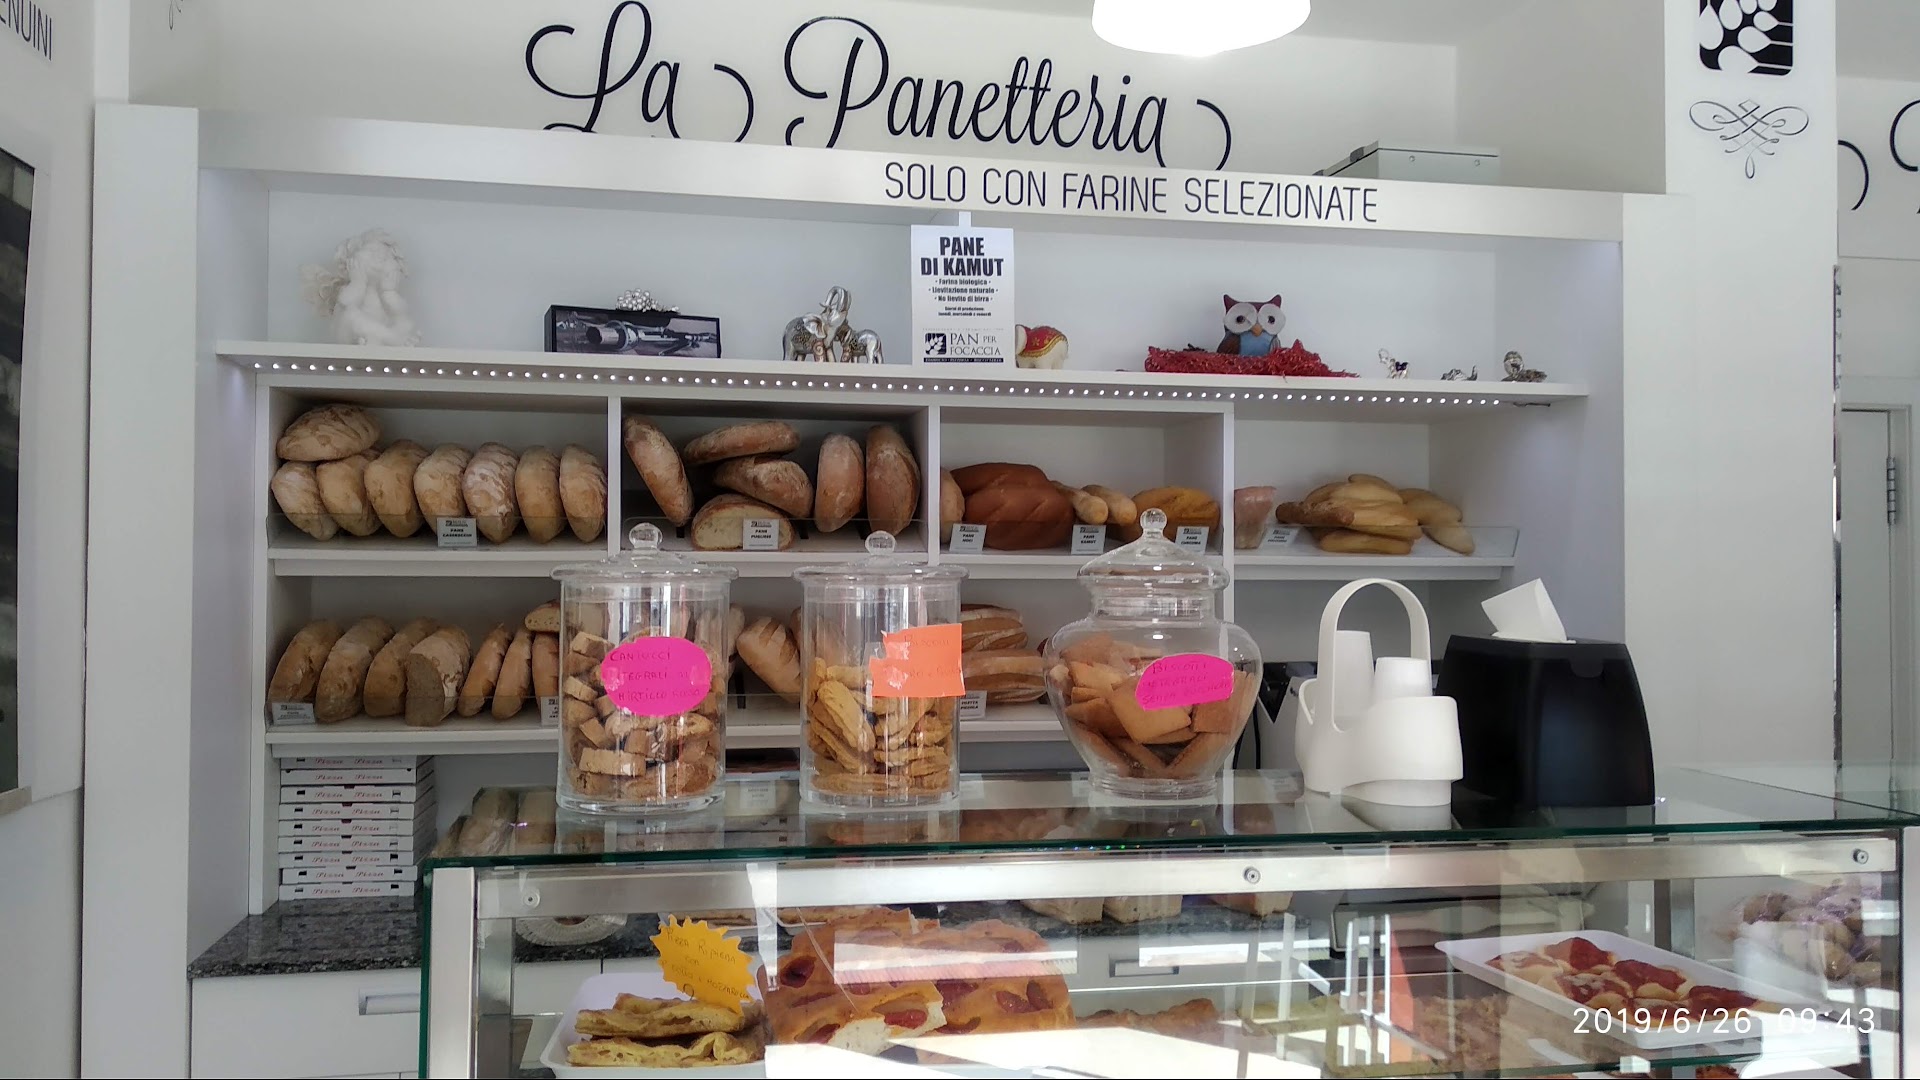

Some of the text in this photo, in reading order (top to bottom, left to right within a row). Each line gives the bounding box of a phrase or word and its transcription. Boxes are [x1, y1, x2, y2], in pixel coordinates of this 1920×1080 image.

[525, 0, 1172, 168] La Panetteria
[885, 162, 1379, 224] SOLO CON FARINE SELEZIONATE
[939, 237, 985, 256] PANE
[920, 257, 1004, 277] DI KAMUT
[958, 278, 988, 286] biologica
[932, 286, 968, 294] Lievitazione
[950, 332, 997, 345] PAN PER
[950, 346, 1001, 356] FOCACCIA
[609, 646, 671, 661] CANTUCCI
